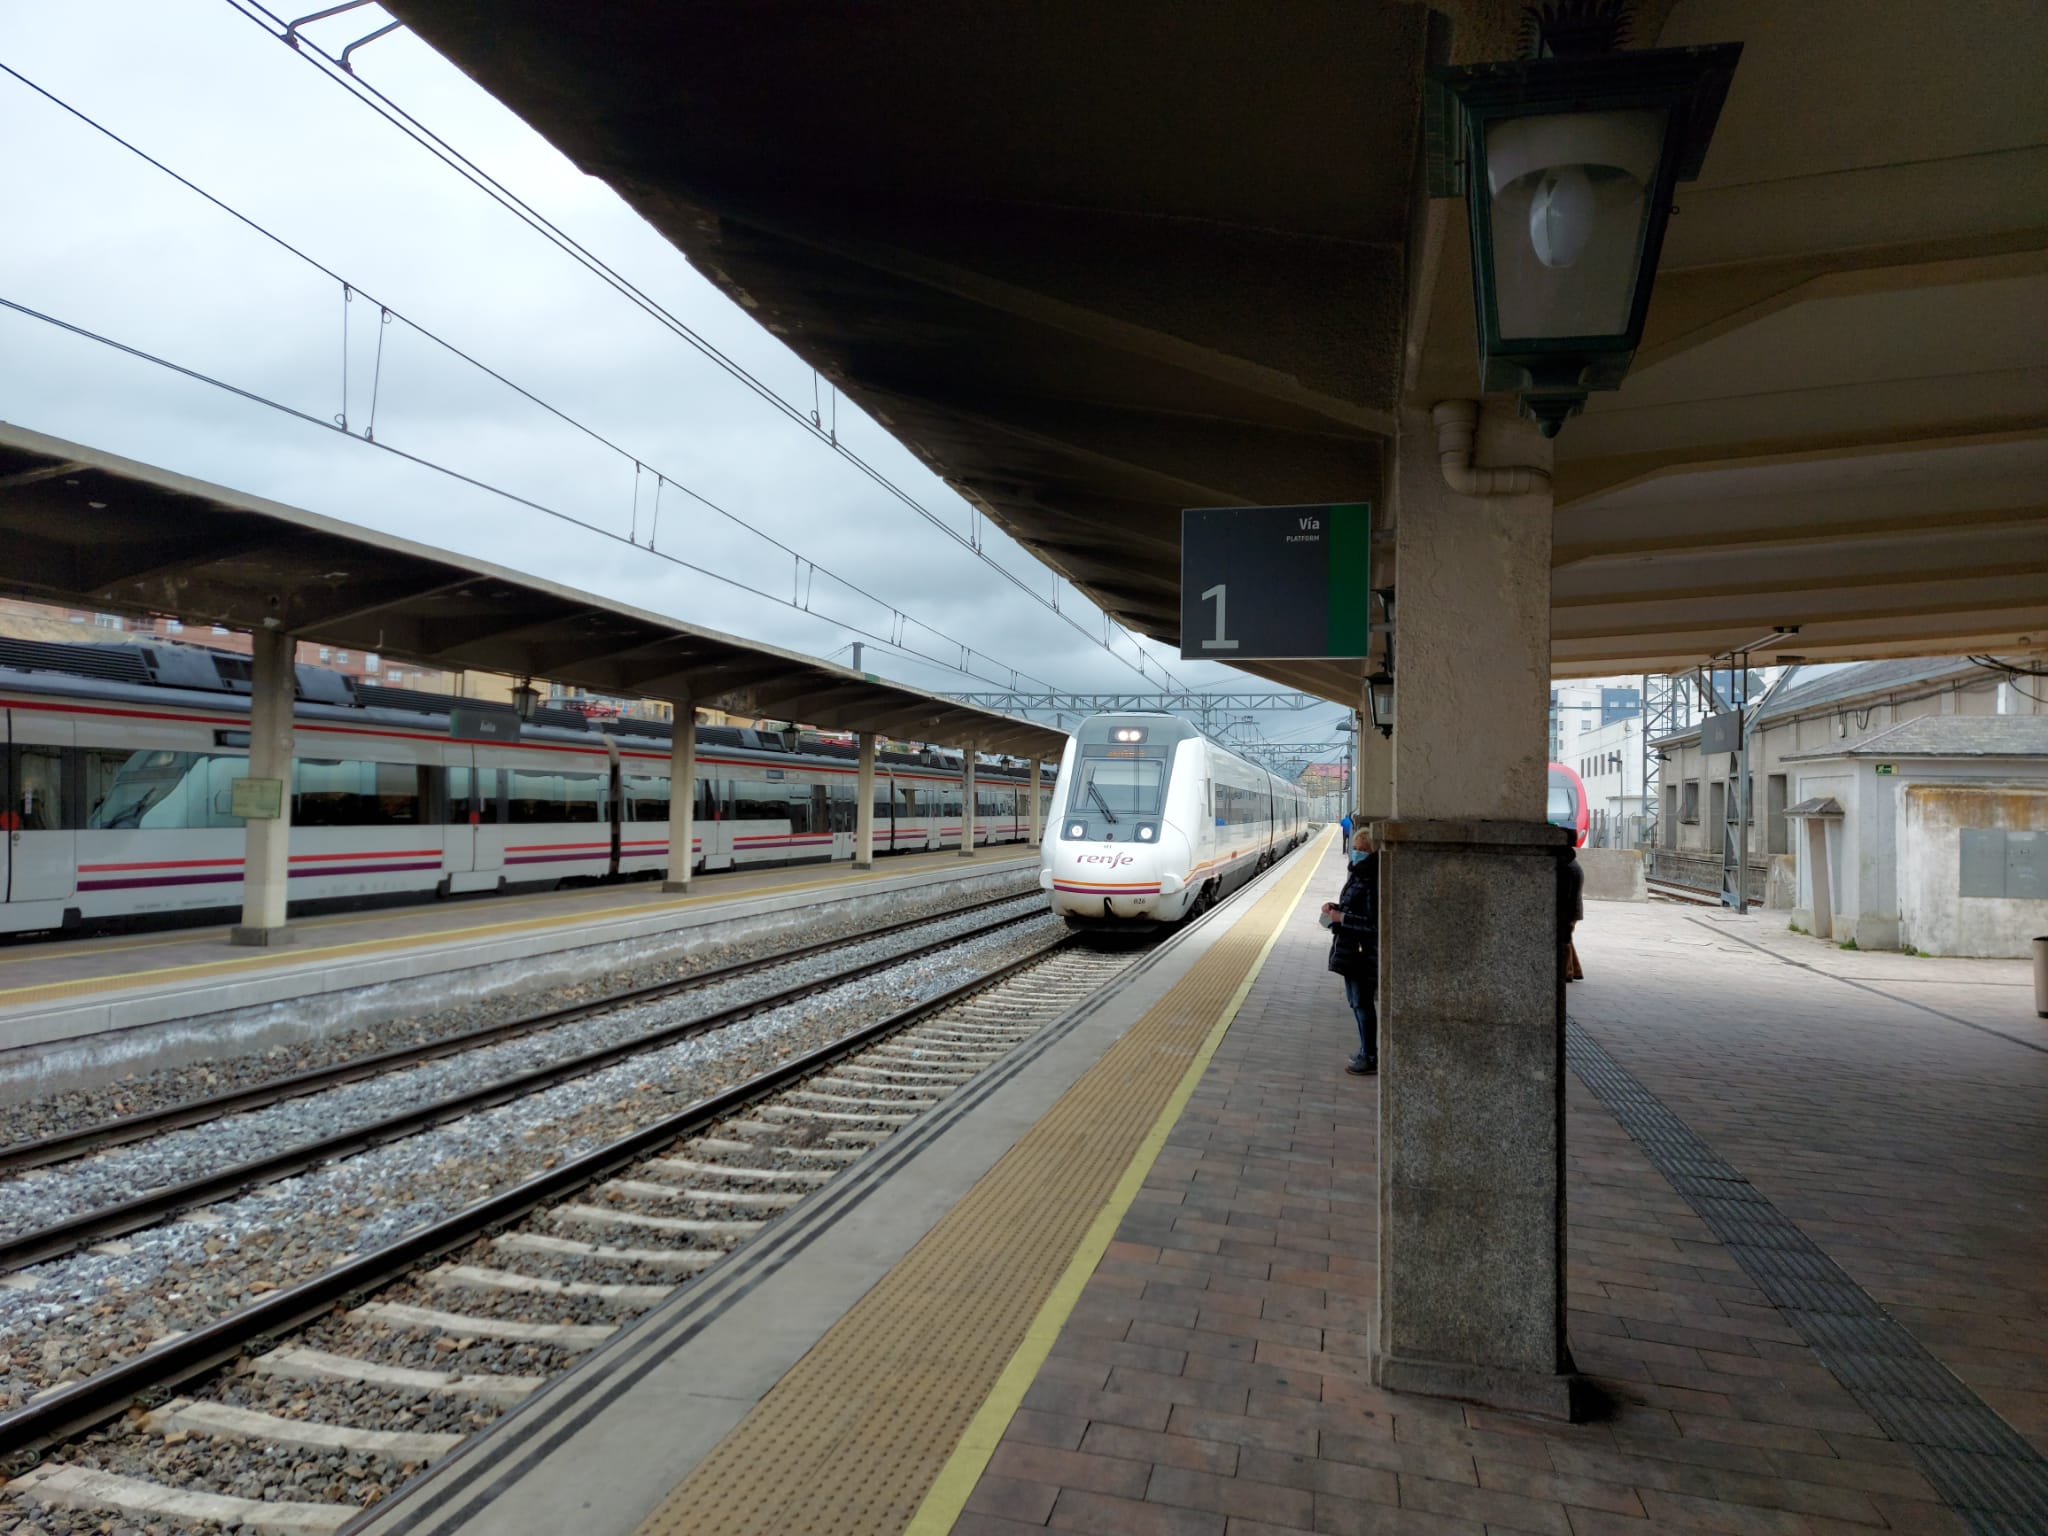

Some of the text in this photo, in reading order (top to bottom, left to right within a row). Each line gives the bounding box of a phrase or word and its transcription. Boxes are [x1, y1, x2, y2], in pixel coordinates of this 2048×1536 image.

[1298, 516, 1320, 530] Vía
[1201, 583, 1239, 649] 1
[1076, 851, 1134, 869] renfe
